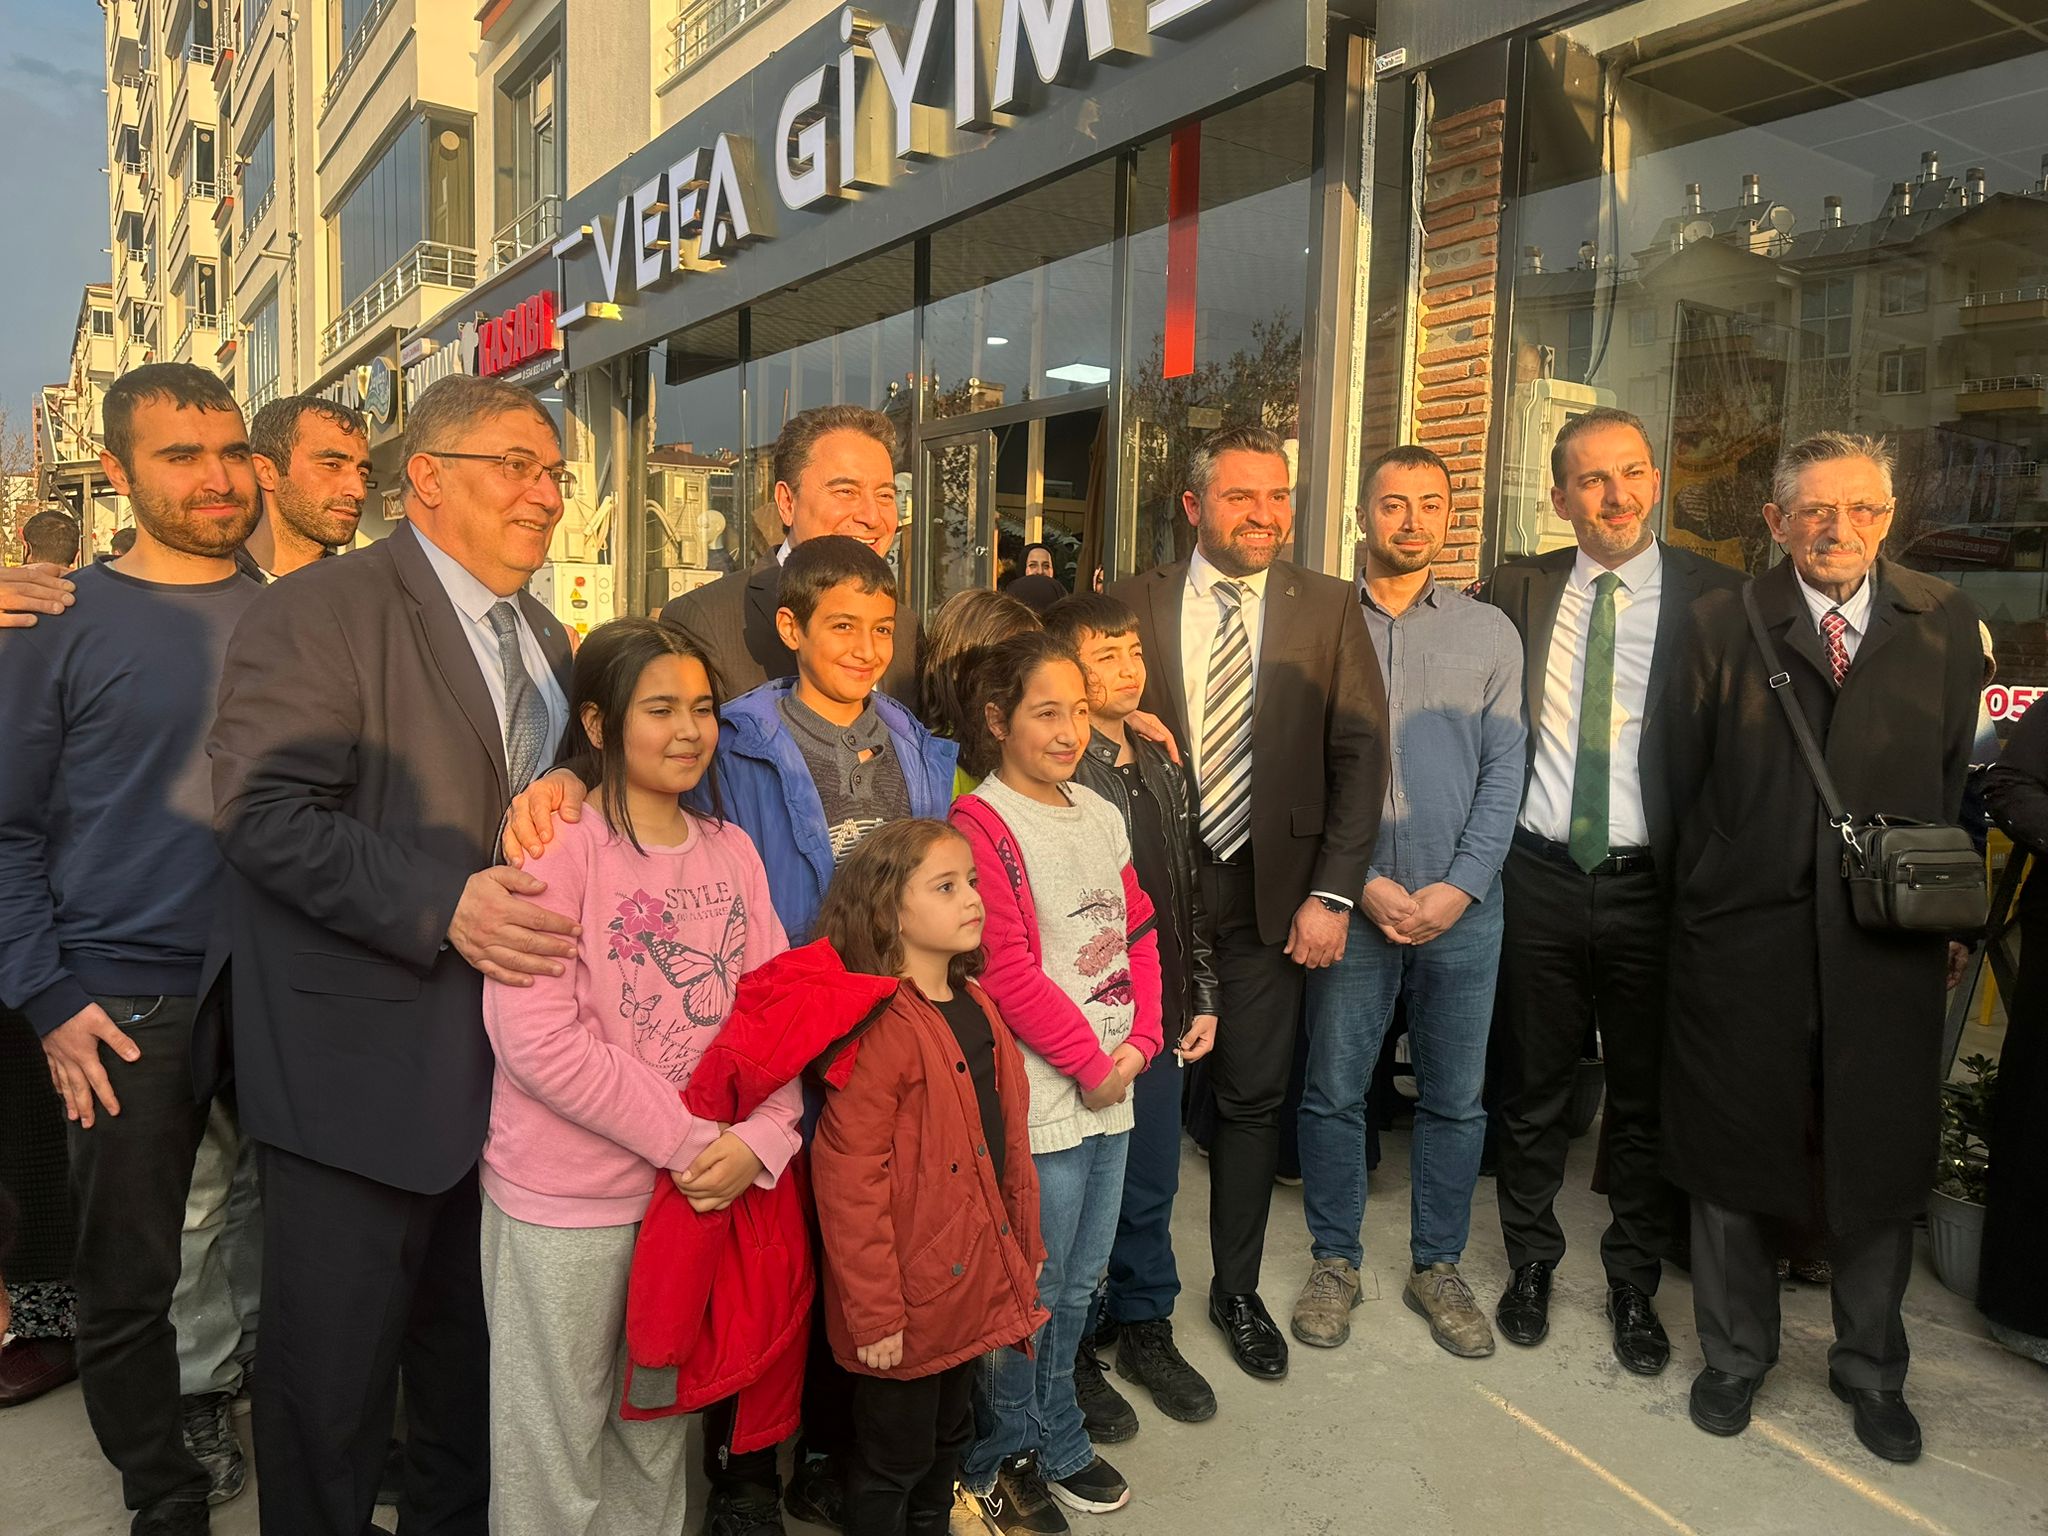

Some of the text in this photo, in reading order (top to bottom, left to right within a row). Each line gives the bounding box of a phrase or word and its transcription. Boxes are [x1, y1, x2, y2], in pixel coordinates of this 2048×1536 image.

[590, 132, 751, 303] VEFA
[478, 290, 551, 377] KASABI
[1985, 687, 2046, 719] 05
[665, 882, 732, 909] STYLE
